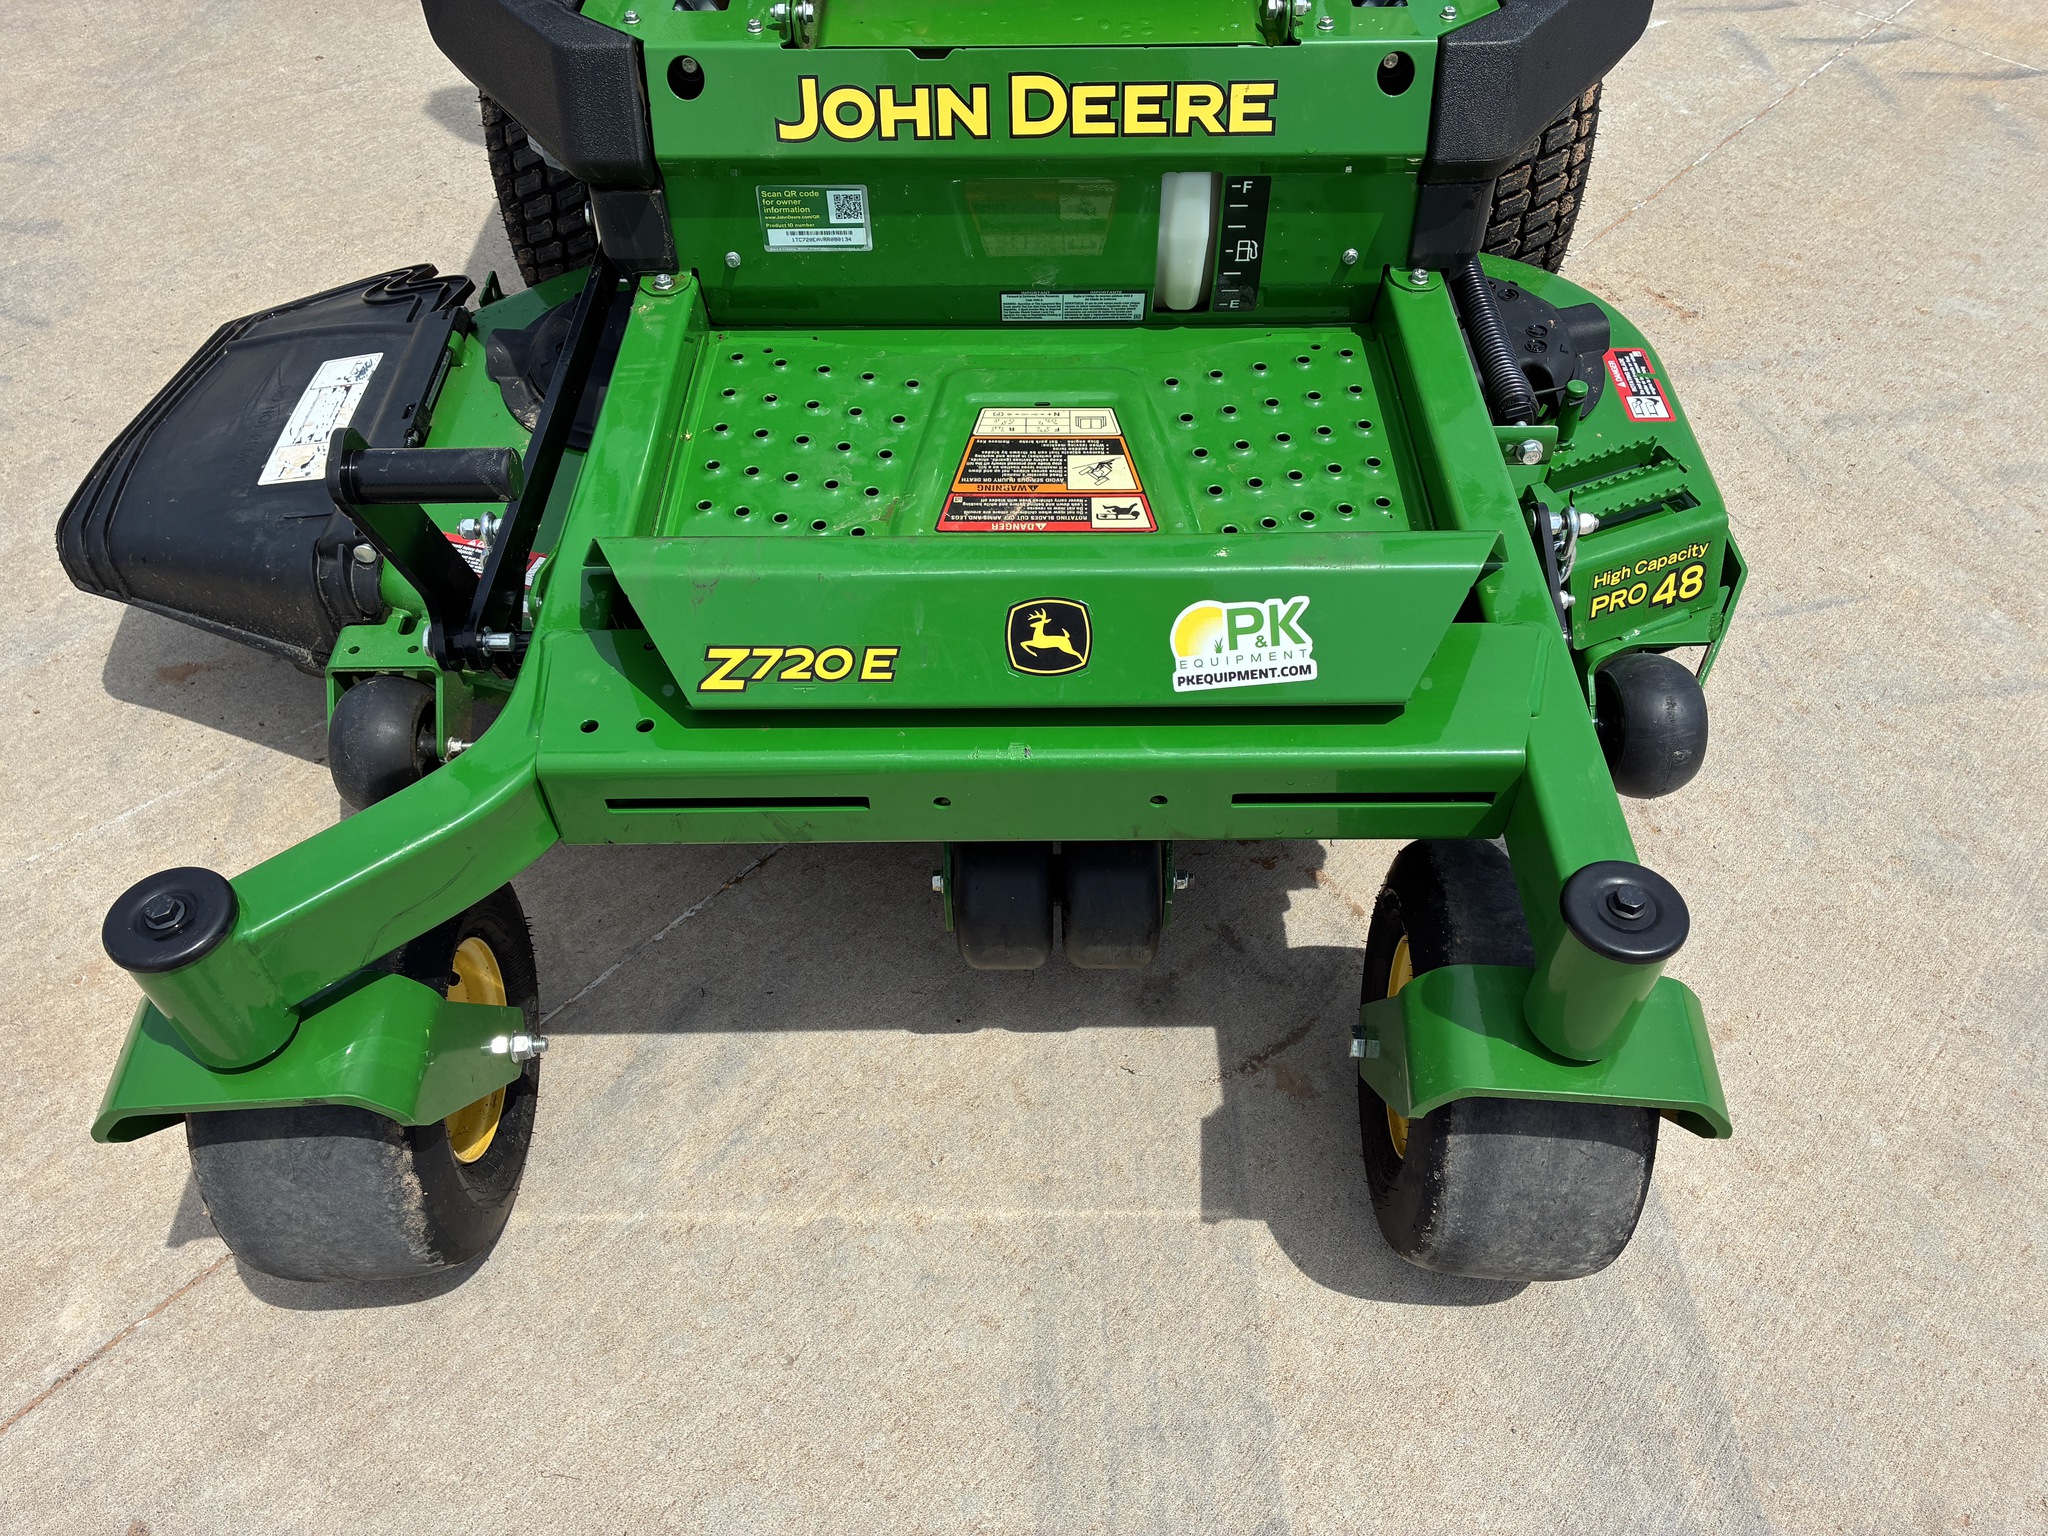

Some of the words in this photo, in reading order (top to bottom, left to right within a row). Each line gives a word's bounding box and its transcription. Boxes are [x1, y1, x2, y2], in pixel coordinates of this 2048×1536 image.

[777, 76, 990, 141] JOHN
[1009, 72, 1278, 137] DEERE
[761, 190, 782, 198] Scan
[784, 191, 797, 199] QR
[1243, 181, 1253, 193] F
[764, 206, 810, 214] information
[1230, 299, 1240, 308] E
[1607, 360, 1623, 382] DANGER
[1593, 567, 1631, 589] High
[1634, 541, 1711, 576] Capacity
[1590, 581, 1648, 620] PRO
[1649, 561, 1706, 609] 48
[1226, 601, 1306, 651] P&K
[1179, 648, 1307, 670] EQUIPMENT
[1177, 664, 1312, 687] PKEQUIPMENT.COM
